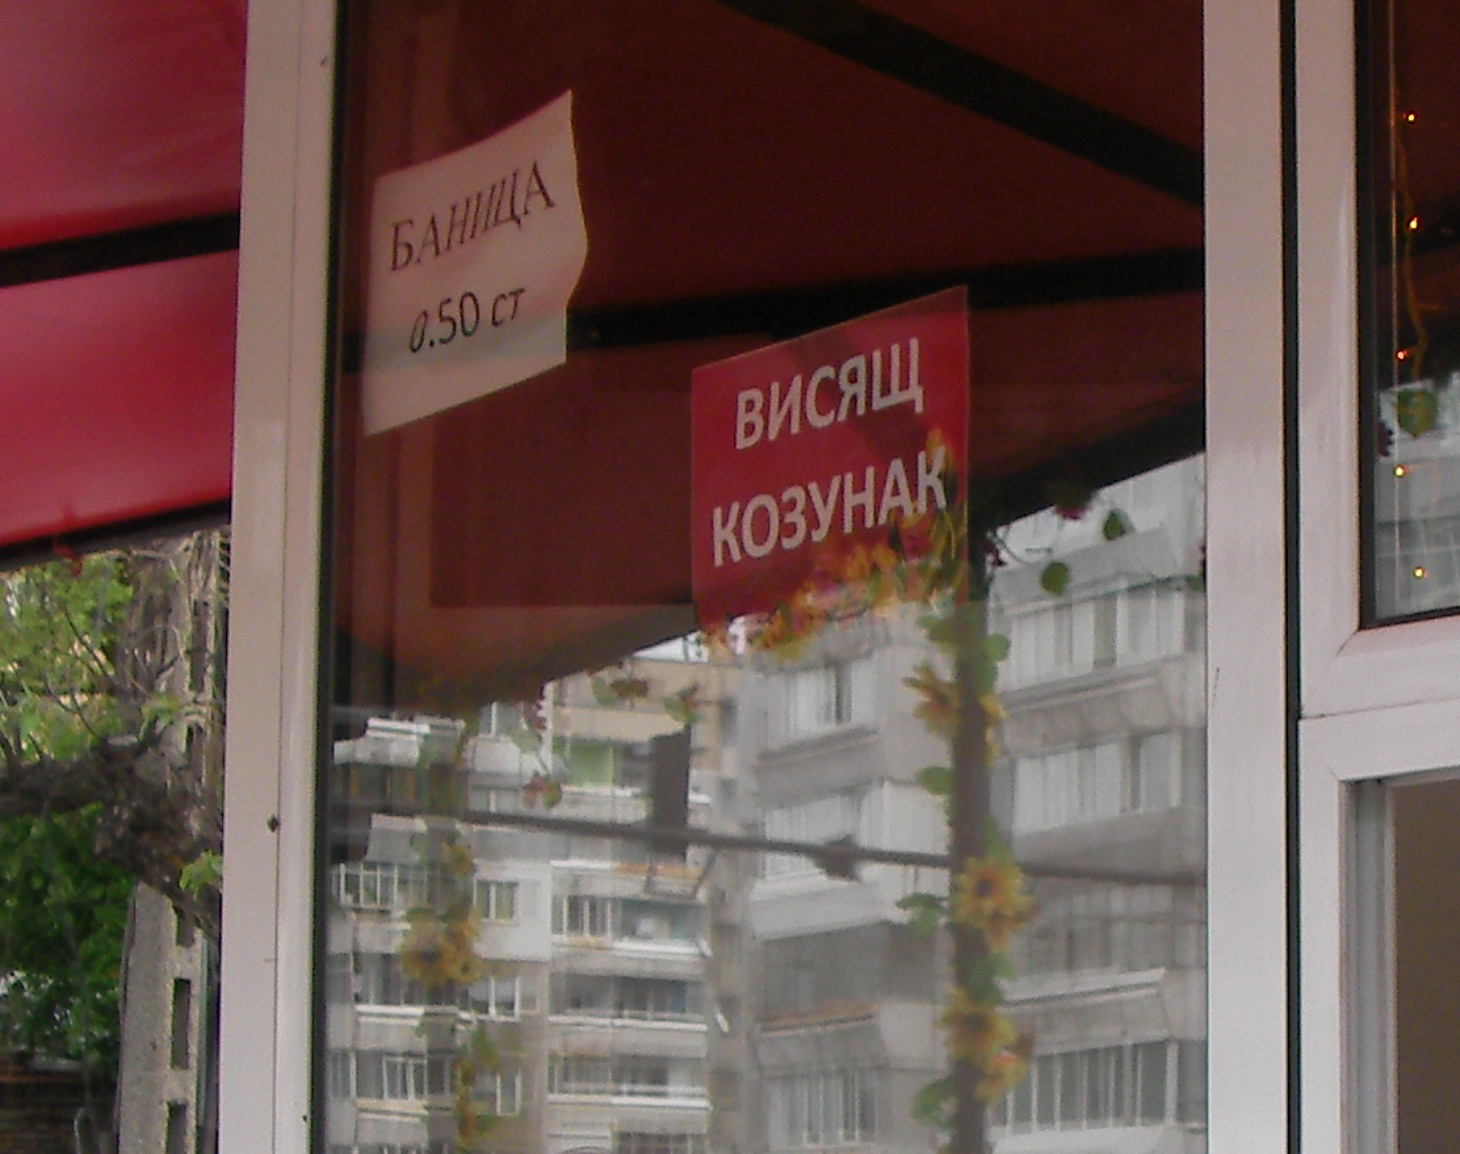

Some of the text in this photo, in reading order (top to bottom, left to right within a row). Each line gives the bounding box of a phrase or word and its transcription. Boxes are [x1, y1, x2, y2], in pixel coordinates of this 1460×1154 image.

[391, 160, 555, 271] БАНИЦА
[410, 291, 480, 353] 0.50
[735, 337, 924, 451] ВИСЯЩ
[712, 445, 947, 568] КОЗУНАК
